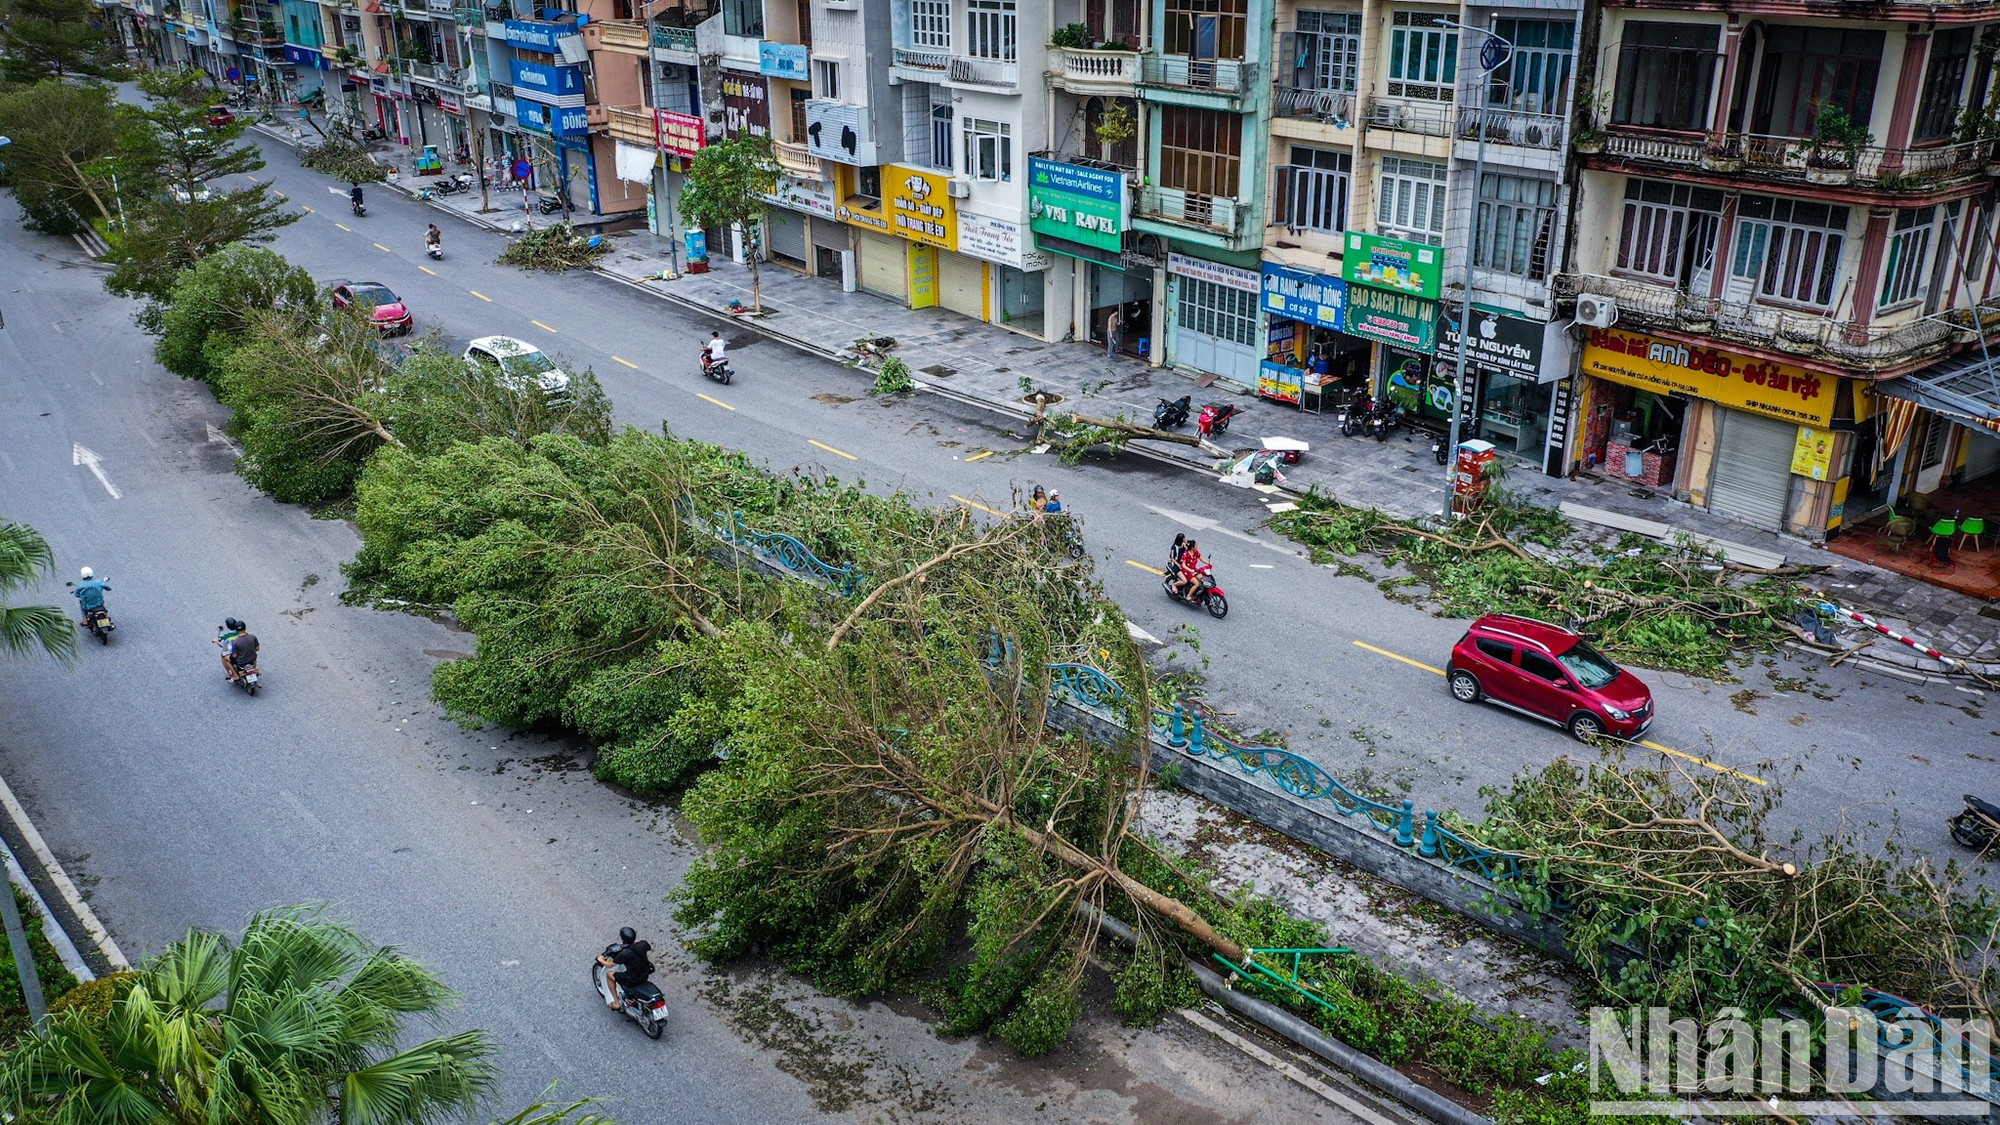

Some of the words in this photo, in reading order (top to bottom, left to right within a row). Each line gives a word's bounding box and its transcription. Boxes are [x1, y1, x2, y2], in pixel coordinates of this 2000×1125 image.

[1350, 286, 1369, 309] GẠO
[1370, 290, 1396, 314] SẠCH
[1397, 294, 1418, 319] TÂM
[1418, 301, 1434, 322] AN
[1308, 308, 1313, 316] 2
[1480, 339, 1531, 360] NGUYỄN
[1745, 399, 1758, 408] SHIP
